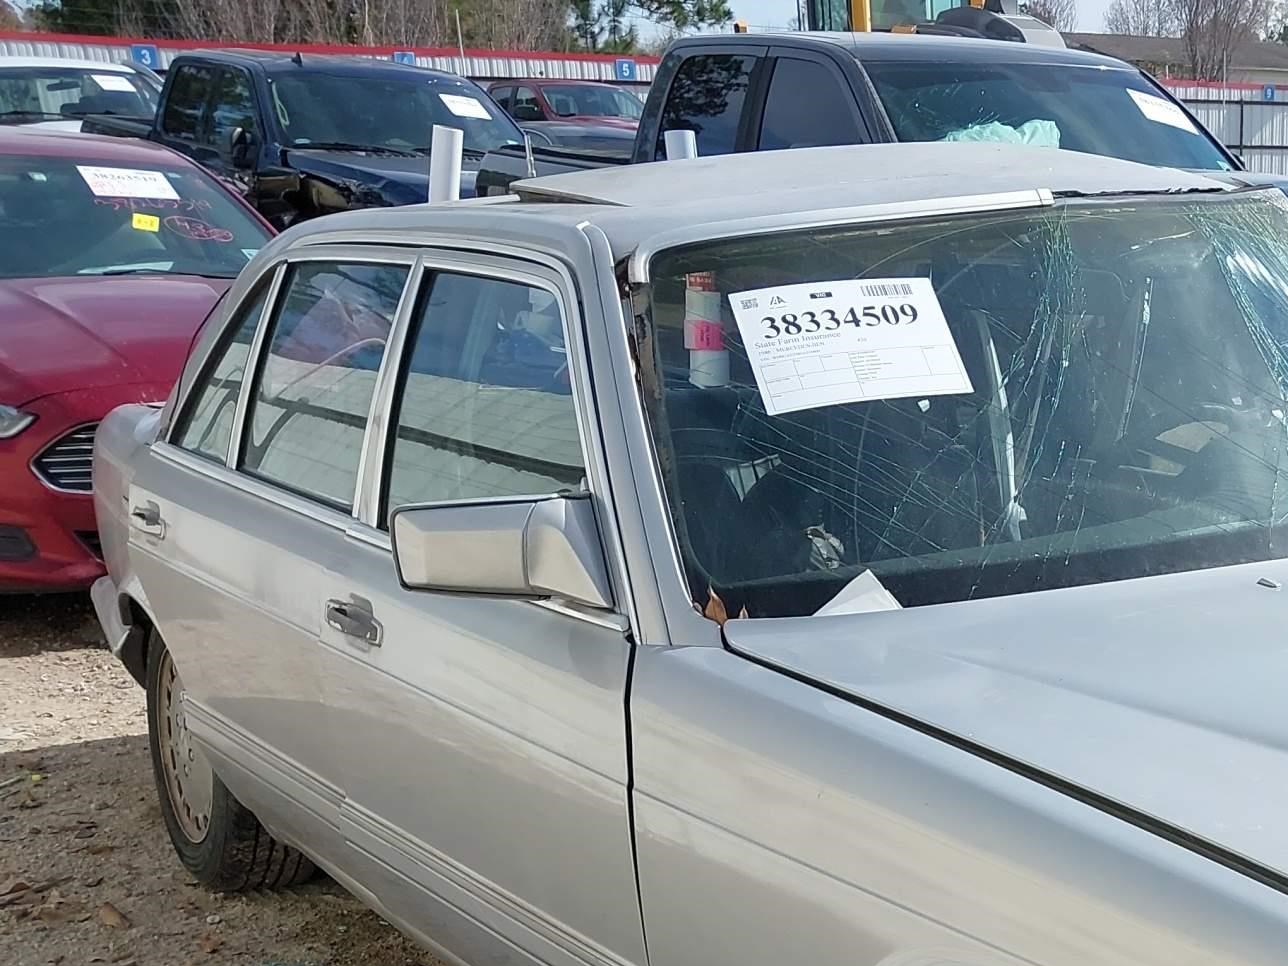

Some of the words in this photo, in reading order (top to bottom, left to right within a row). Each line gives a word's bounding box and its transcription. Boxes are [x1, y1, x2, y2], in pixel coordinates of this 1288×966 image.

[140, 49, 152, 66] 3
[622, 62, 631, 77] 5
[761, 303, 918, 339] 38334509
[754, 340, 776, 350] State
[777, 336, 800, 346] Farm
[801, 332, 841, 342] Insurance
